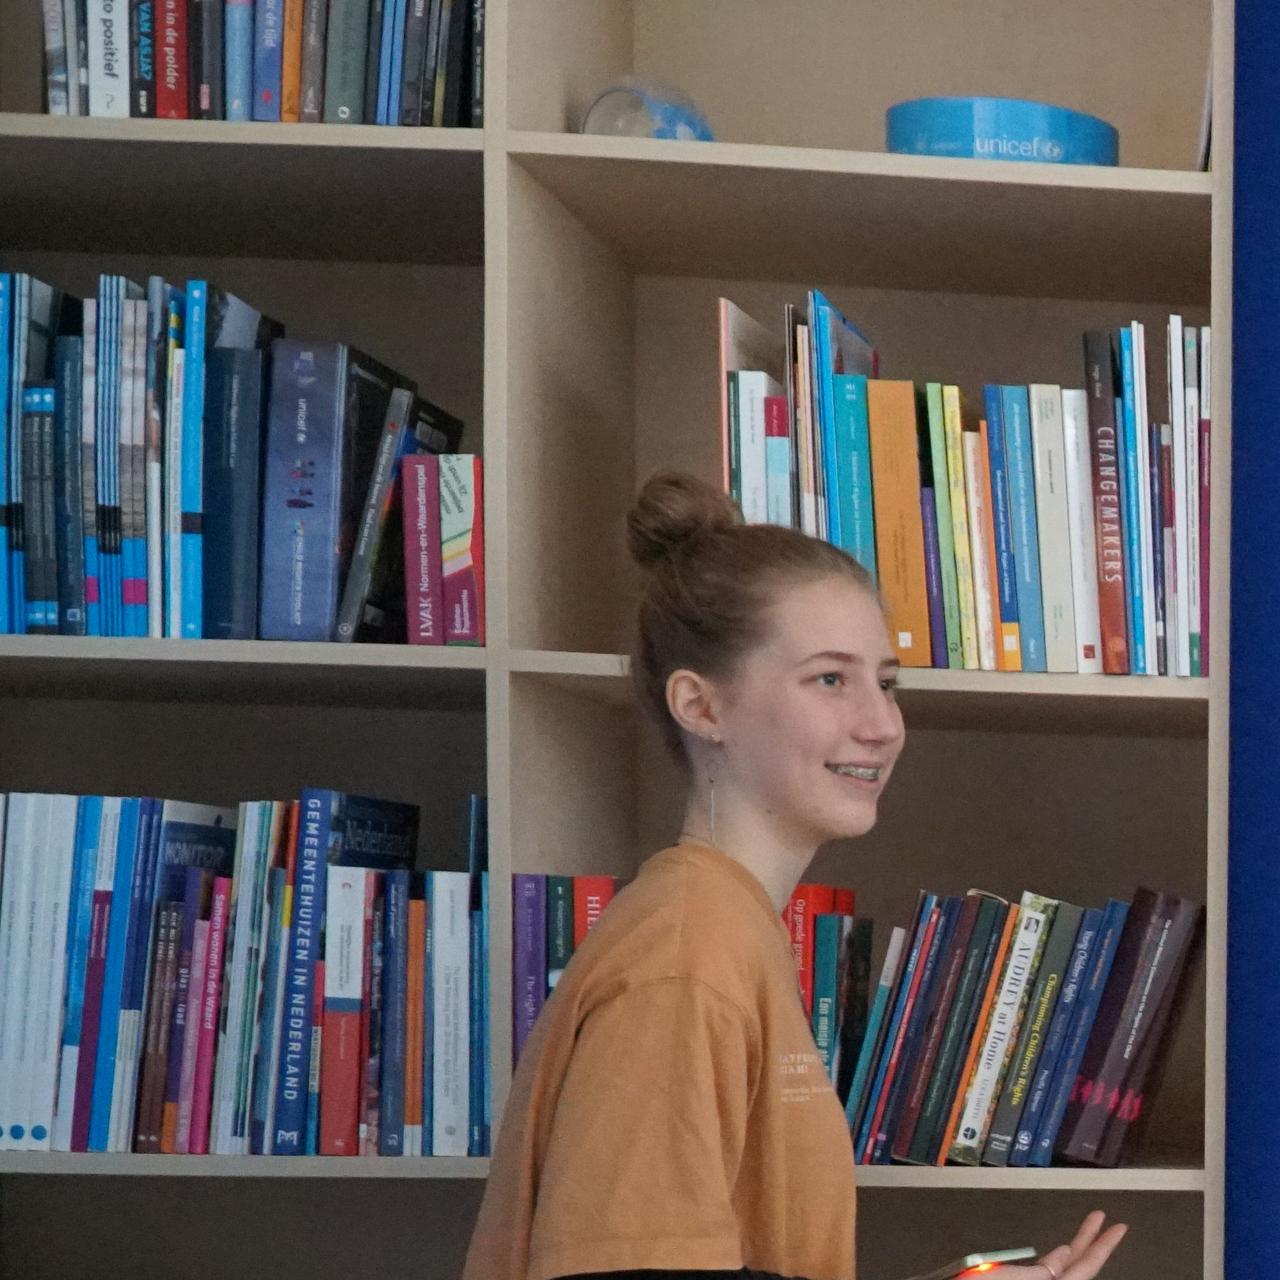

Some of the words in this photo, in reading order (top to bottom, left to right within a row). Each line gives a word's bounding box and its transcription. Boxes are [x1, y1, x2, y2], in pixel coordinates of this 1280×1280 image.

[101, 18, 119, 79] positief
[162, 47, 179, 90] polder
[975, 134, 1040, 156] unicef
[297, 398, 307, 433] unicef
[1096, 426, 1122, 584] CHANGEMAKERS
[295, 798, 321, 960] GEMEENTEHUIZEN
[212, 893, 225, 929] Samen
[792, 898, 806, 912] Op
[209, 931, 220, 967] wonen
[206, 981, 217, 994] de
[294, 968, 308, 987] IN
[999, 942, 1032, 1010] AUDREY
[204, 996, 214, 1030] Waard
[819, 997, 832, 1014] Een
[995, 1012, 1009, 1026] at
[1031, 973, 1058, 1031] Championing
[283, 993, 306, 1101] NEDERLAND
[982, 1028, 1009, 1071] Home
[1019, 1032, 1043, 1076] Children's
[1010, 1077, 1031, 1105] Rights
